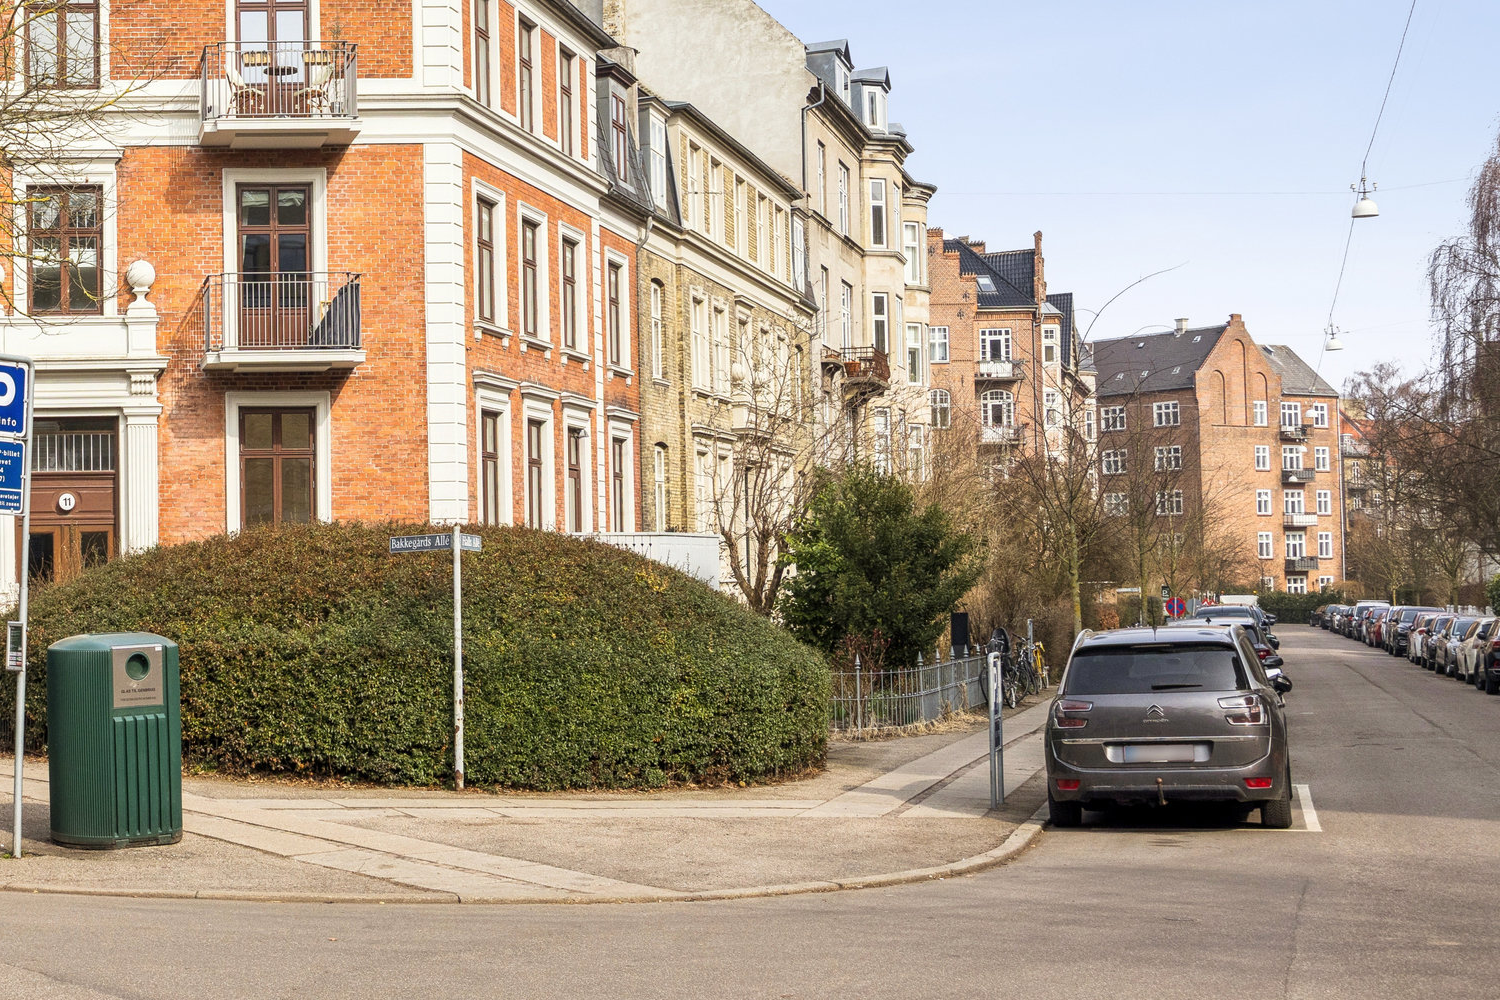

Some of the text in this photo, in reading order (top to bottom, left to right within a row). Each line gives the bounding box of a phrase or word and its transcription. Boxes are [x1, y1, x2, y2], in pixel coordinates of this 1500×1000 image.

[63, 498, 71, 506] 11
[391, 535, 450, 549] Bakkegårds Allé
